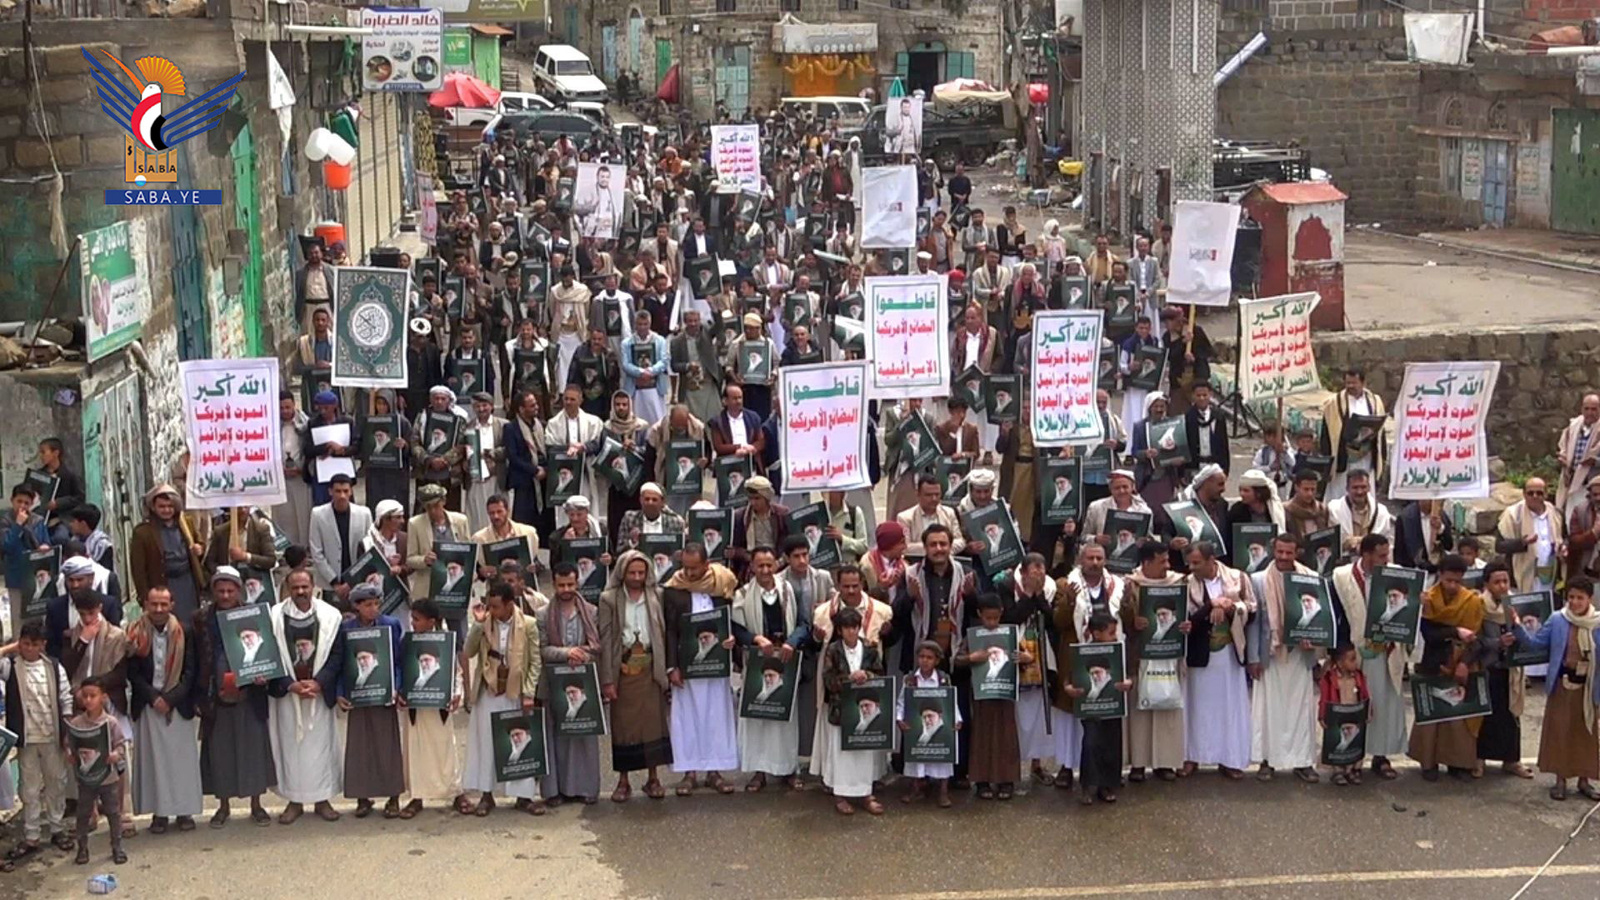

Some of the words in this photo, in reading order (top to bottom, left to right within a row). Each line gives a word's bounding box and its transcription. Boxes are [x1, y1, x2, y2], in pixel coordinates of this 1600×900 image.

[412, 15, 439, 26] خالد
[876, 291, 936, 315] قاطعوا
[1252, 300, 1289, 326] أكبر
[1291, 301, 1311, 315] الله
[1038, 319, 1074, 349] أكبر
[1075, 322, 1096, 341] الله
[904, 341, 908, 355] و
[1071, 350, 1093, 366] الموت
[193, 373, 236, 402] أكبر
[238, 374, 266, 395] الله
[1071, 372, 1091, 388] الموت
[1287, 369, 1314, 391] النصر
[1408, 373, 1458, 400] أكبر
[1458, 375, 1484, 395] الله
[788, 376, 859, 406] قاطعوا
[234, 404, 267, 422] الموت
[828, 408, 858, 430] البضائع
[1072, 410, 1094, 434] النصر
[236, 426, 269, 443] الموت
[822, 435, 827, 451] و
[245, 447, 270, 461] اللعنة
[1403, 447, 1432, 461] اليهود
[1434, 447, 1451, 461] على
[239, 468, 273, 491] النصر
[1441, 465, 1476, 487] النصر
